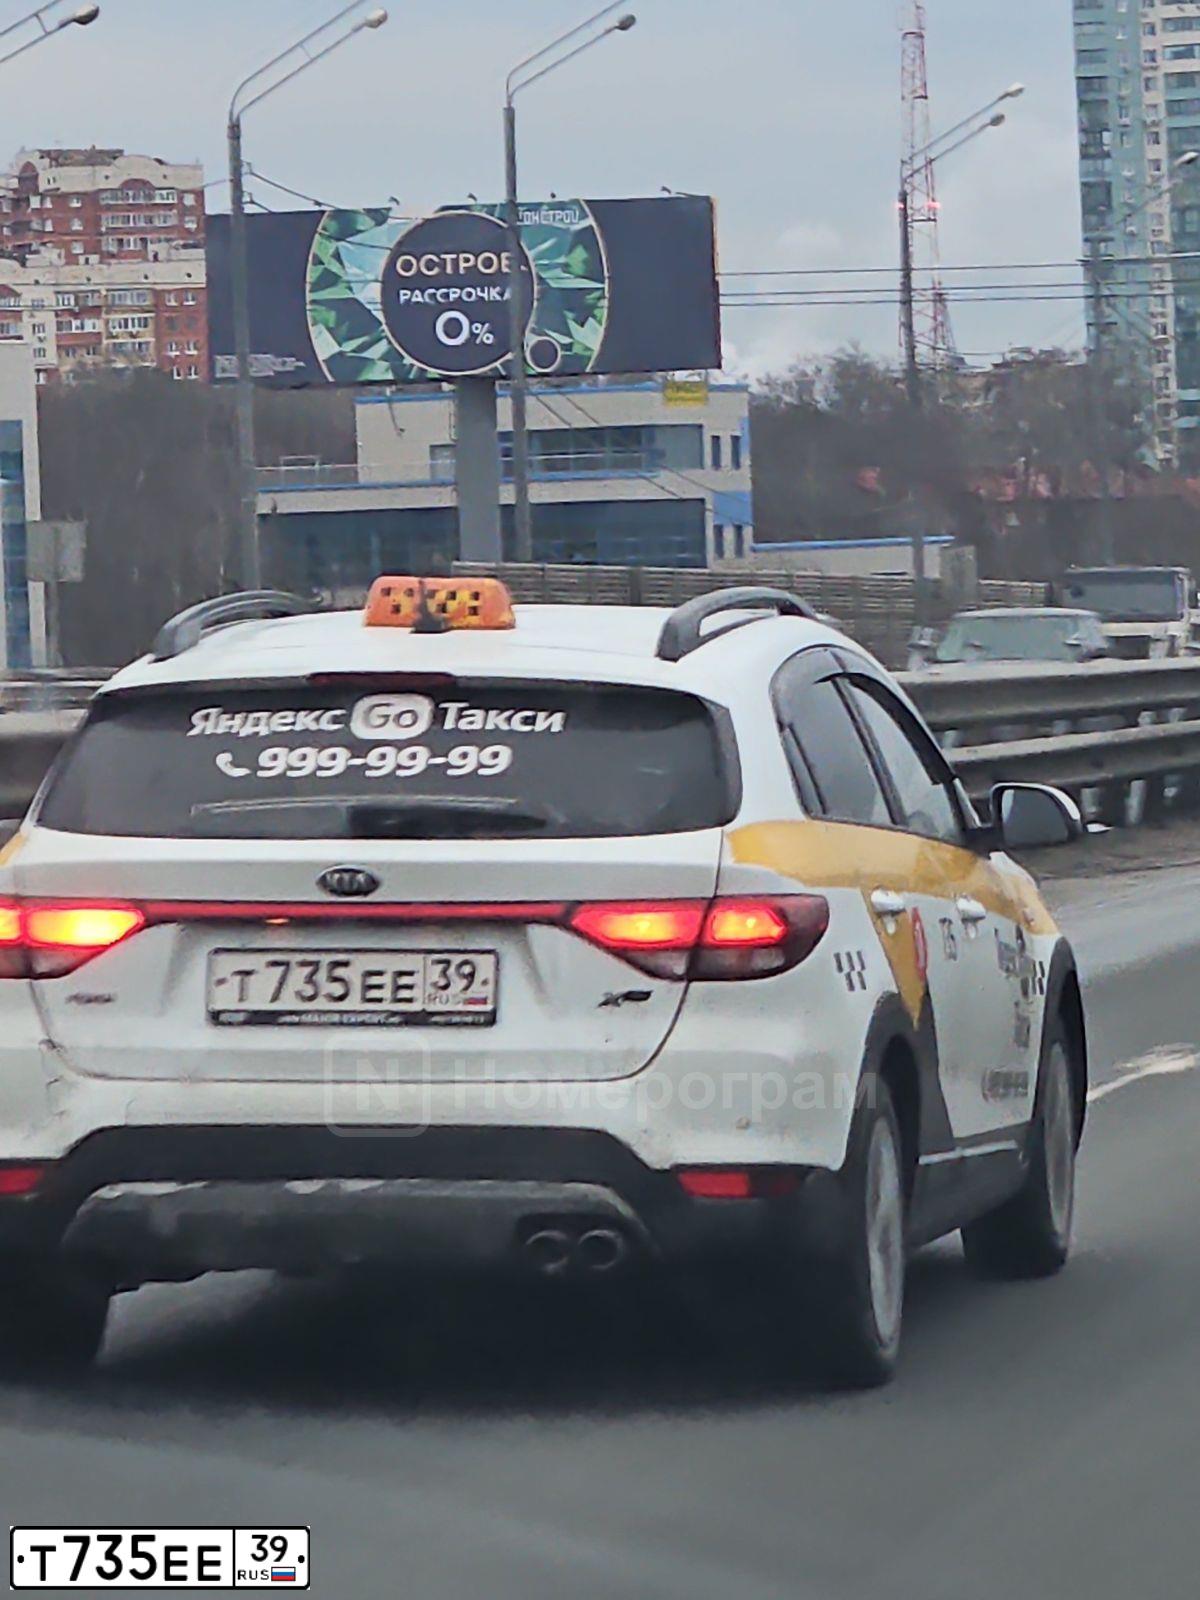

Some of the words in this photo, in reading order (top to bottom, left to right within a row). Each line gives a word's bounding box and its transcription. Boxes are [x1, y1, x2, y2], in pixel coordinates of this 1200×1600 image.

[435, 310, 494, 346] 0%
[186, 707, 347, 737] Яндекс
[438, 702, 567, 733] Такси
[256, 745, 514, 778] 999-99-99
[429, 959, 477, 992] 39
